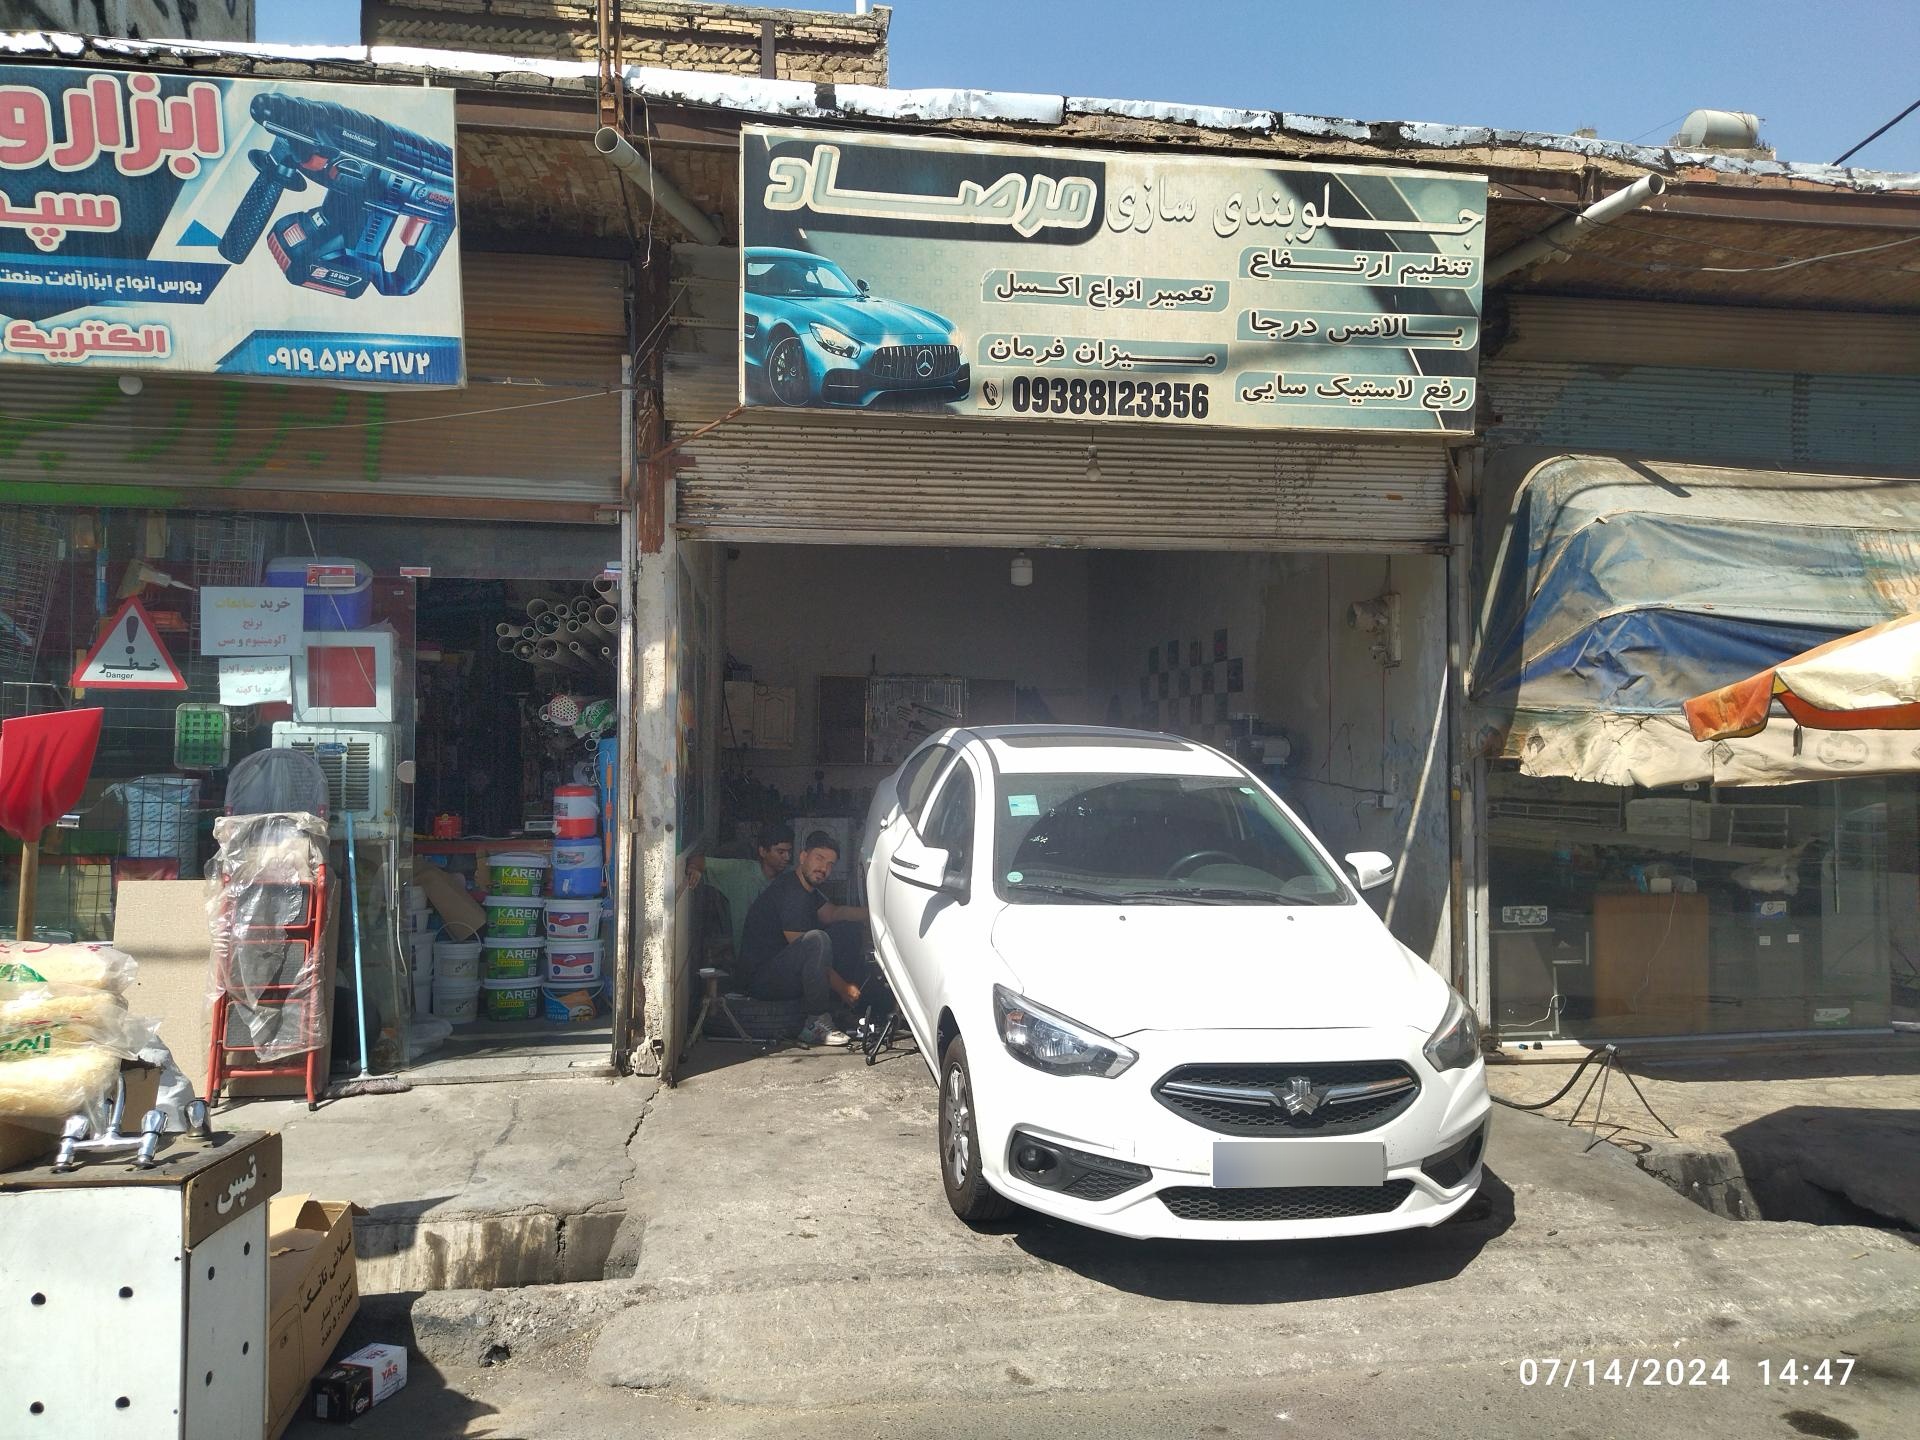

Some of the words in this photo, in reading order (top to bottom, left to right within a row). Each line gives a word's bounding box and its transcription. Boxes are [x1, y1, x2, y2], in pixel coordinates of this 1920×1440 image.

[51, 74, 223, 177] ابزار
[764, 145, 1096, 237] مرصاد
[1106, 174, 1197, 233] سازی
[0, 192, 120, 250] سپ
[1212, 181, 1484, 250] جلوبندی
[1250, 248, 1389, 278] ارتفاع
[1400, 256, 1472, 283] تنظیم
[115, 275, 155, 293] انواع
[158, 280, 203, 294] بورس
[996, 272, 1080, 301] اکسل
[1088, 277, 1141, 307] انواع
[1150, 283, 1214, 307] تعمیر
[1251, 311, 1317, 338] درجا
[1329, 315, 1463, 342] بالانس
[5, 320, 170, 362] الکتریک
[990, 338, 1065, 363] فرمان
[1074, 342, 1216, 369] میزان
[1013, 376, 1209, 418] 09388123356
[1242, 375, 1307, 403] سایی
[1317, 378, 1413, 405] لاستیک
[1422, 382, 1467, 409] رفع
[260, 597, 290, 612] خرید
[99, 657, 160, 673] خطر
[106, 672, 134, 680] Danger
[501, 868, 543, 879] KAREN
[497, 908, 539, 919] KAREN
[497, 948, 539, 959] KAREN
[496, 989, 539, 1000] KAREN
